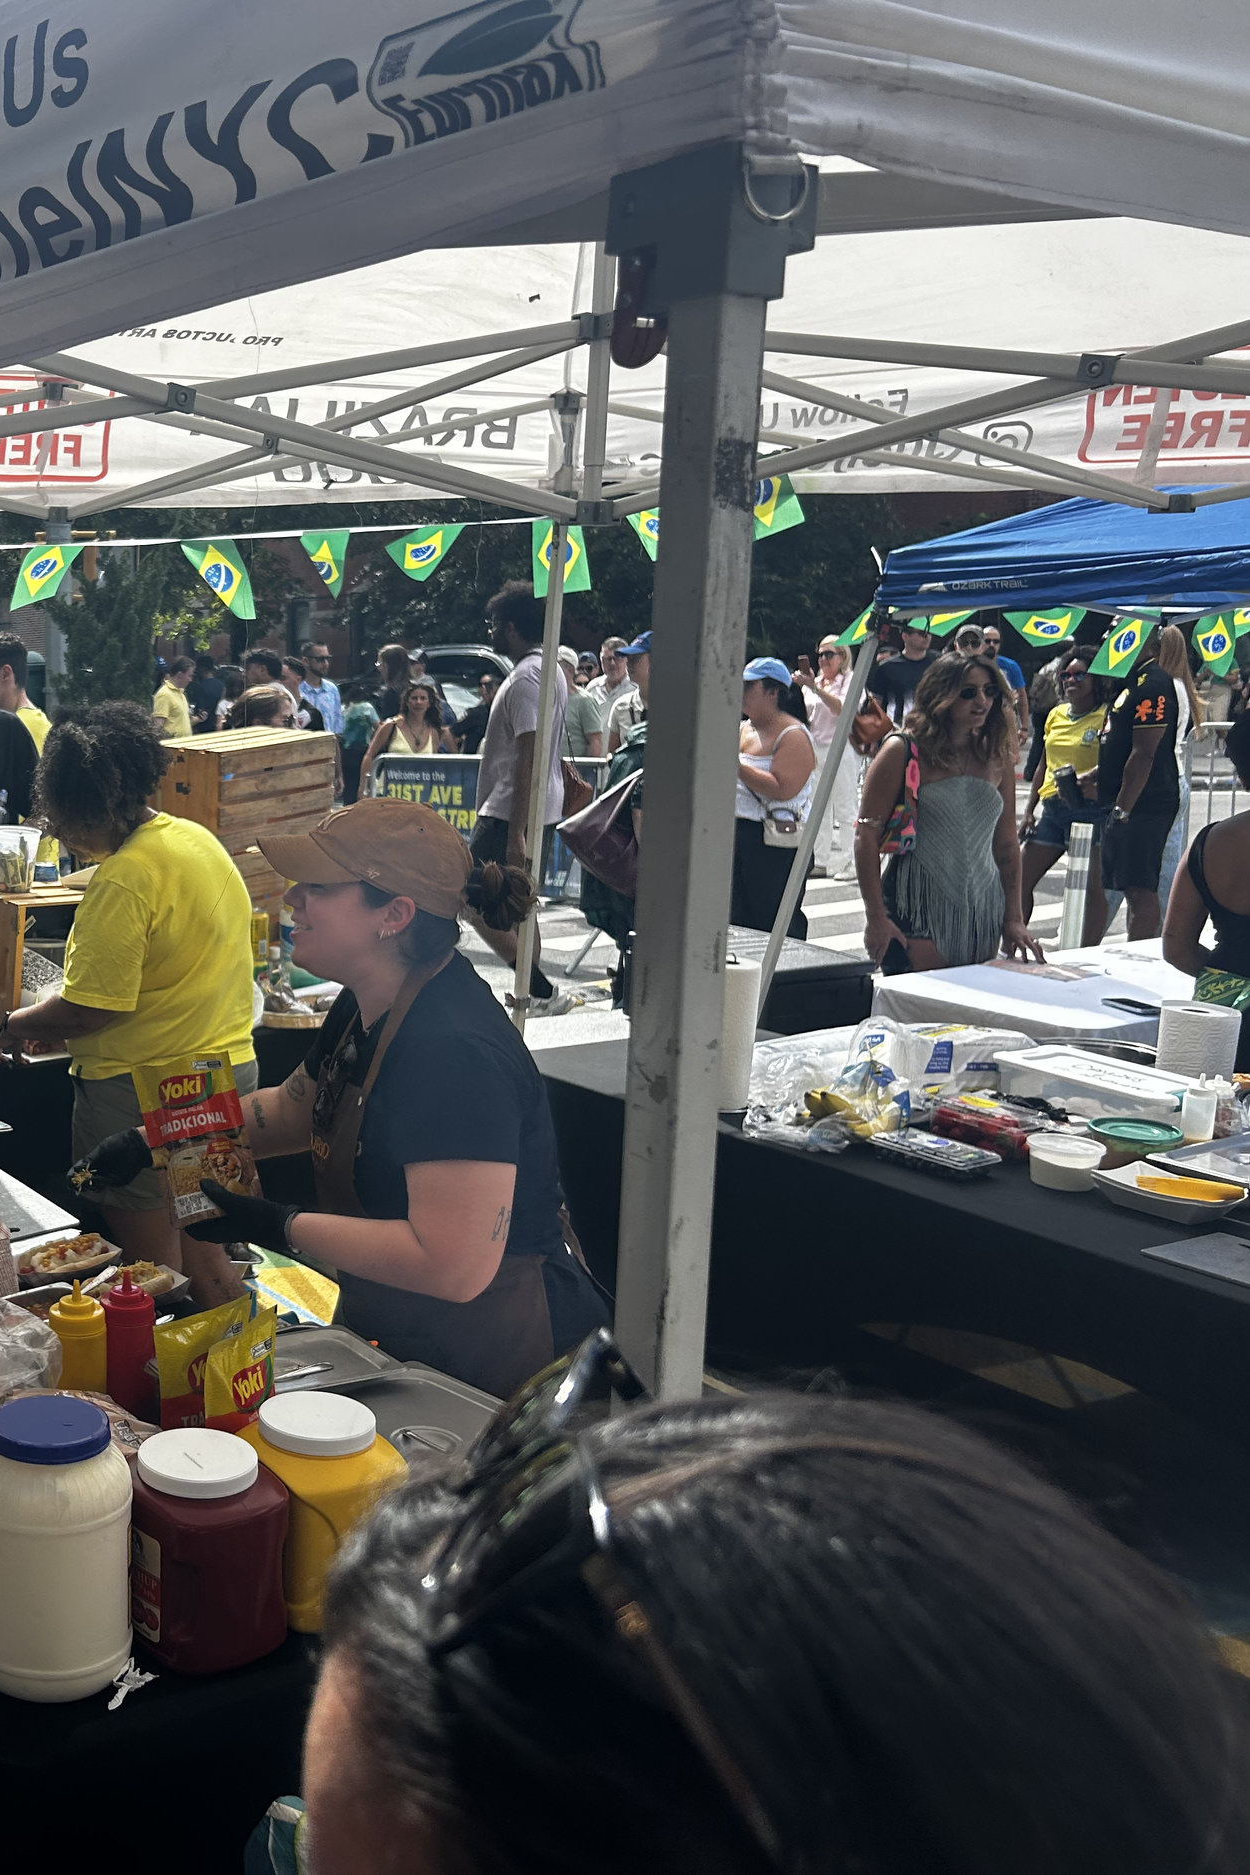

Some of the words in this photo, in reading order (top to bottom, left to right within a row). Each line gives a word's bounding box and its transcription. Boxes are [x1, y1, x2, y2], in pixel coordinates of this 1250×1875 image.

[3, 19, 90, 128] Us
[387, 769, 421, 780] Welcome
[422, 771, 430, 781] to
[432, 770, 446, 781] the
[387, 784, 424, 804] 31ST
[429, 785, 463, 805] AVE
[160, 1076, 201, 1103] Yoki
[159, 1111, 227, 1137] TRADICIONAL
[233, 1366, 265, 1405] Yoki
